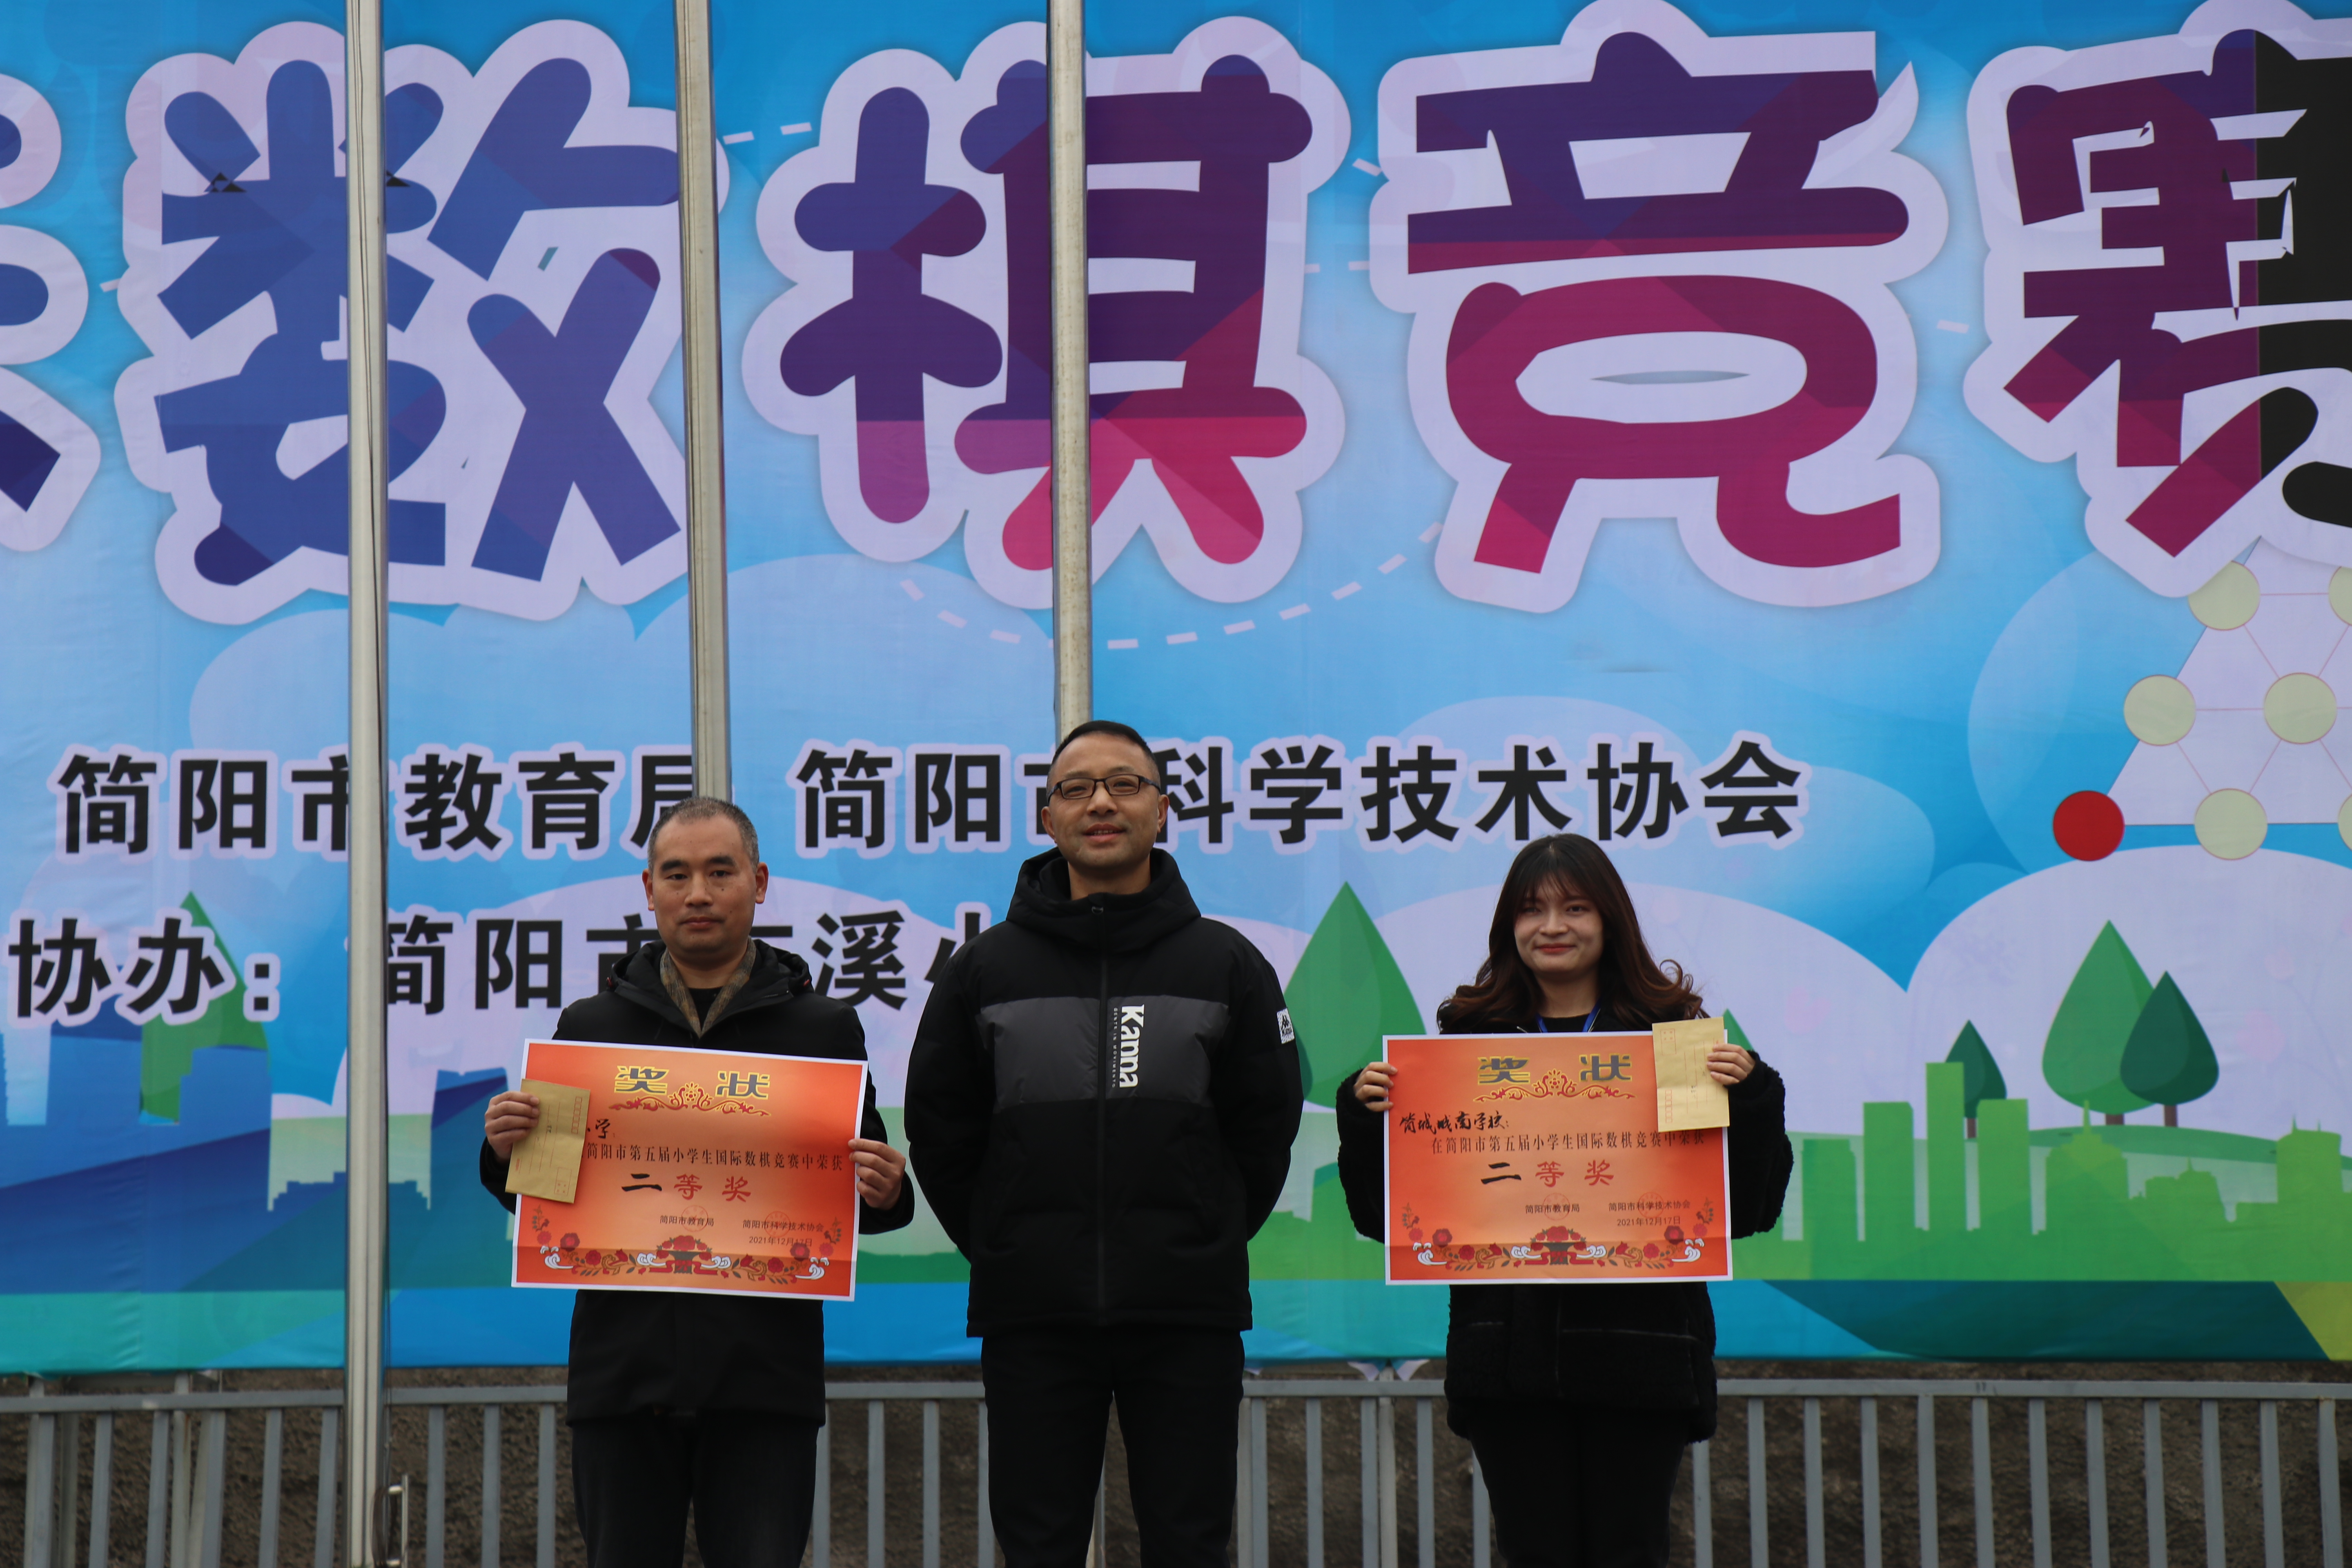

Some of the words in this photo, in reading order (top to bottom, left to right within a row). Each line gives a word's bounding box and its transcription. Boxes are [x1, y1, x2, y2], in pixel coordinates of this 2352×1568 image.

[0, 28, 2352, 585] 数棋竞赛
[8, 917, 269, 1018] 协办：
[614, 1065, 770, 1099] 奖状
[1478, 1053, 1632, 1085] 奖状
[582, 1142, 842, 1171] 简阳市第五届小学生国际数棋竞赛中荣获
[621, 1173, 751, 1202] 二等奖
[1481, 1159, 1614, 1187] 二等奖
[1525, 1203, 1580, 1214] 简阳市教育局
[1609, 1199, 1690, 1212] 简阳市科学技术协会
[660, 1215, 714, 1227] 简阳市教育局
[743, 1220, 824, 1232] 简阳市科学技术协会
[1617, 1216, 1681, 1227] 2021年12月17日
[749, 1236, 813, 1247] 2021年12月17日
